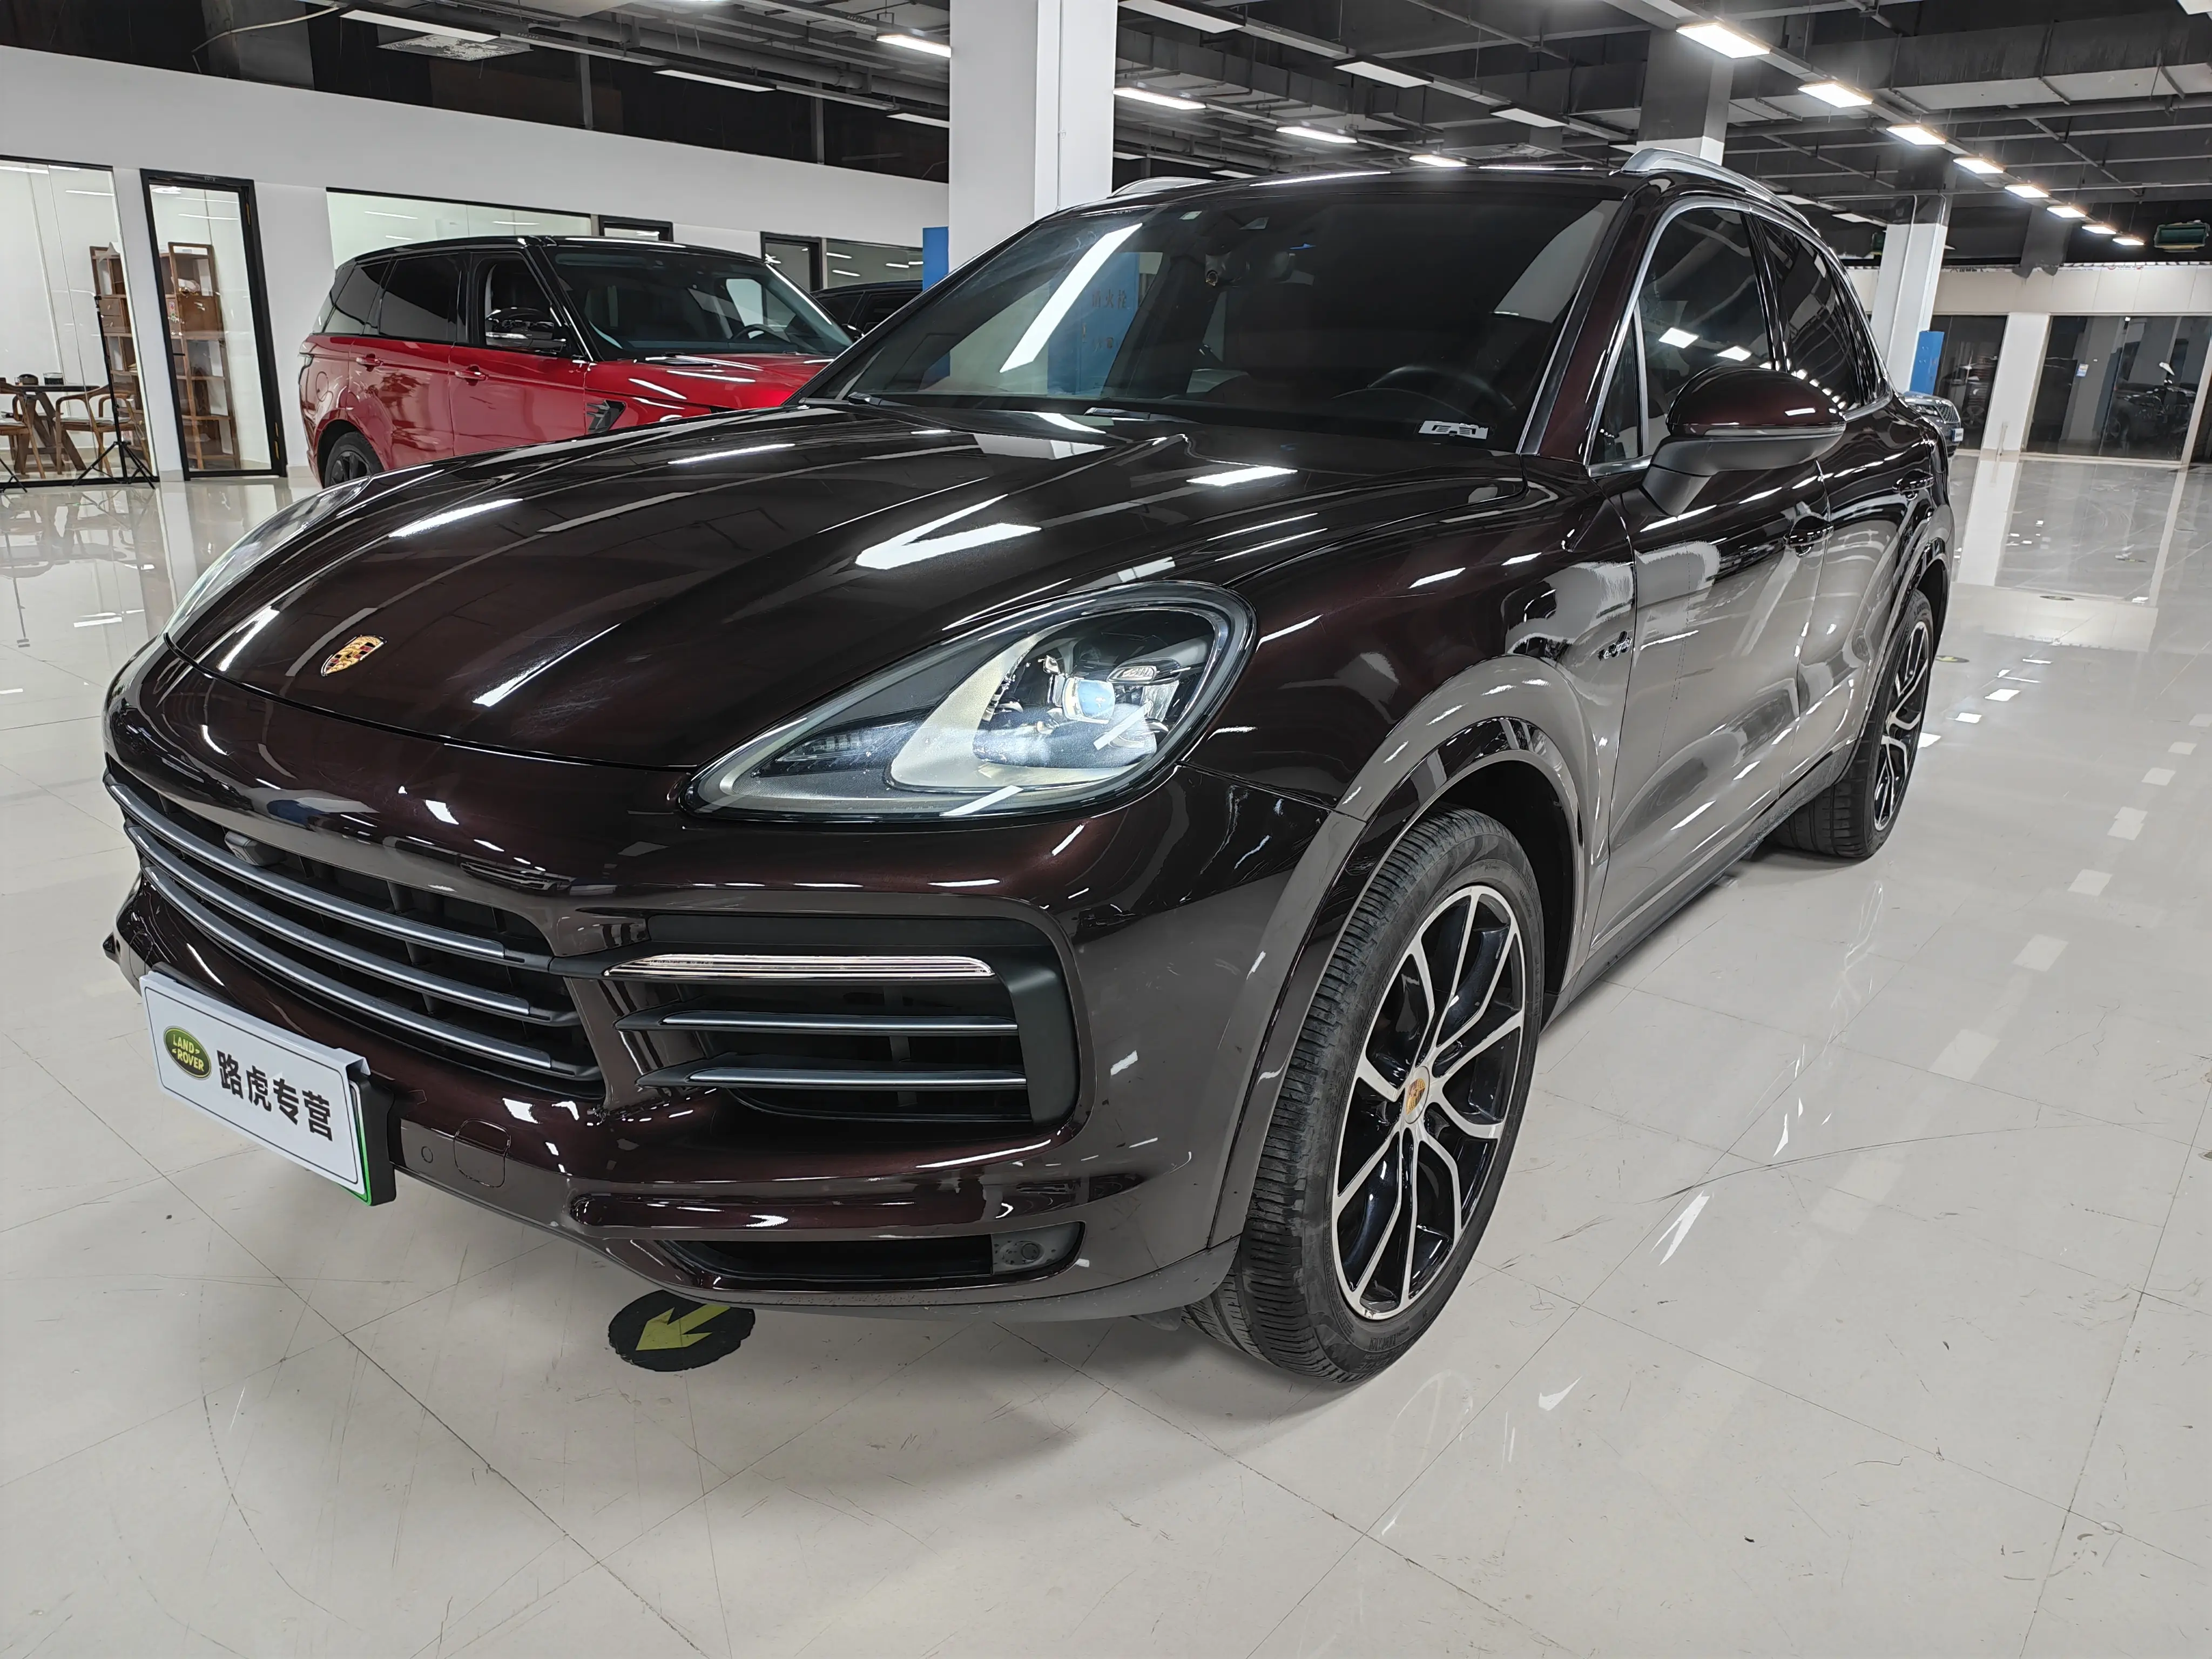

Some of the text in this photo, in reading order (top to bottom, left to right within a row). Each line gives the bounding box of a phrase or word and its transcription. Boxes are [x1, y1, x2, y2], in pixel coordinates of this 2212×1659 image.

[173, 1034, 195, 1054] LAND
[177, 1048, 205, 1072] ROVER
[217, 1050, 333, 1142] 路虎专营
